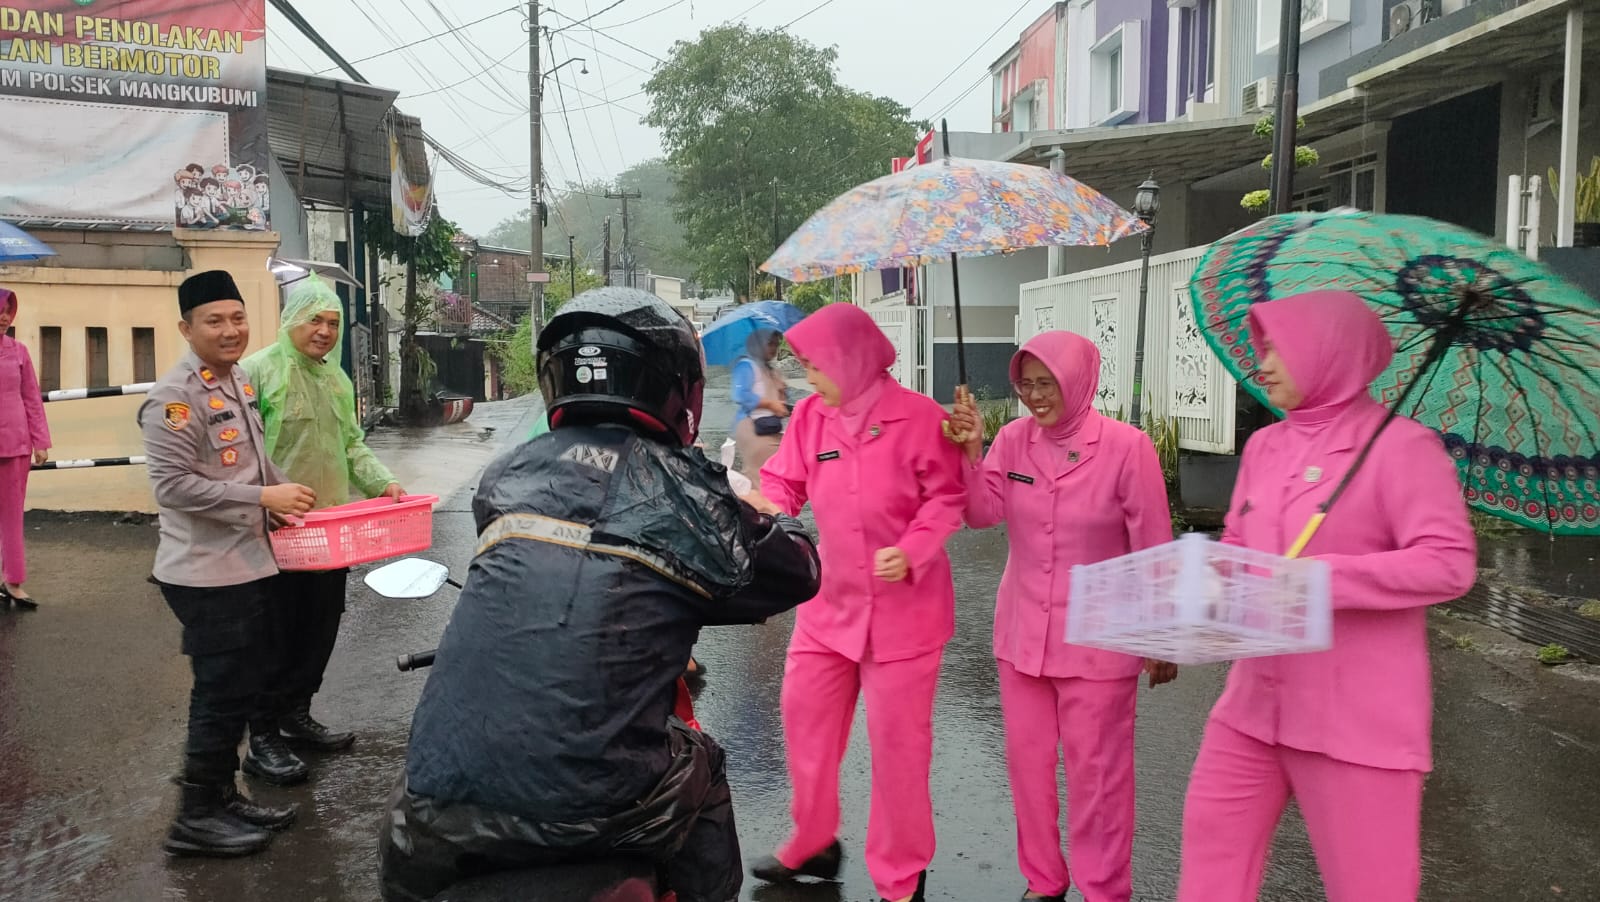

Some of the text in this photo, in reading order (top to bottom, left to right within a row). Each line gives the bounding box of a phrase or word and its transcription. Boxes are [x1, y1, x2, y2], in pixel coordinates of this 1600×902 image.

[0, 7, 242, 54] DAN PENOLAKAN
[62, 42, 220, 79] BERMOTOR
[29, 71, 112, 96] POLSEK
[120, 79, 257, 107] MANGKUBUMI
